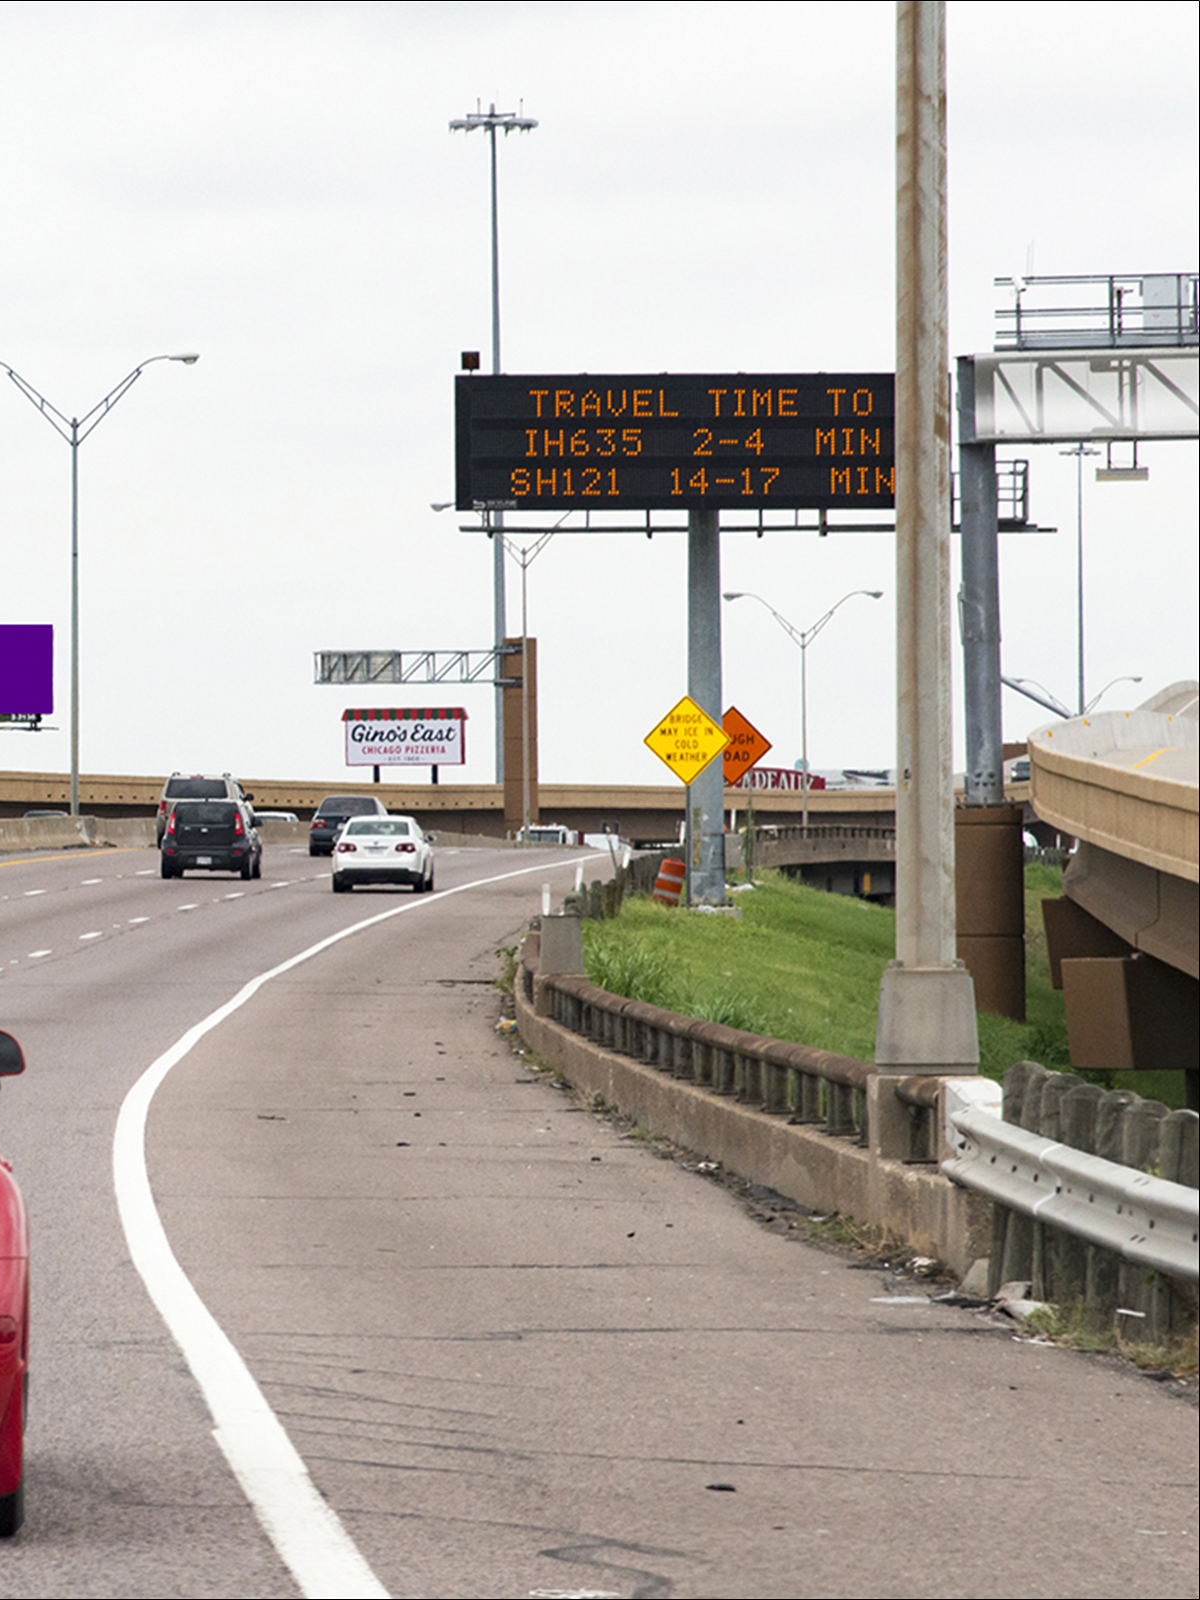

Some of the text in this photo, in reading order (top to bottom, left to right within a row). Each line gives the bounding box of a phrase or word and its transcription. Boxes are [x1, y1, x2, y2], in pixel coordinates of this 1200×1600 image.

[529, 389, 873, 417] TRAVEL TIME TO
[525, 428, 880, 456] IH635 2-4 MIN
[510, 467, 896, 495] SH121 14-17 MIN
[668, 714, 703, 724] BRIDGE
[351, 723, 457, 743] Gino's East
[659, 727, 714, 736] MAY ICE IN
[674, 739, 700, 749] COLD
[729, 733, 755, 745] UGH
[361, 744, 447, 755] CHICAGO PIZZERIA
[666, 752, 708, 762] WEATHER
[723, 750, 751, 762] OAD
